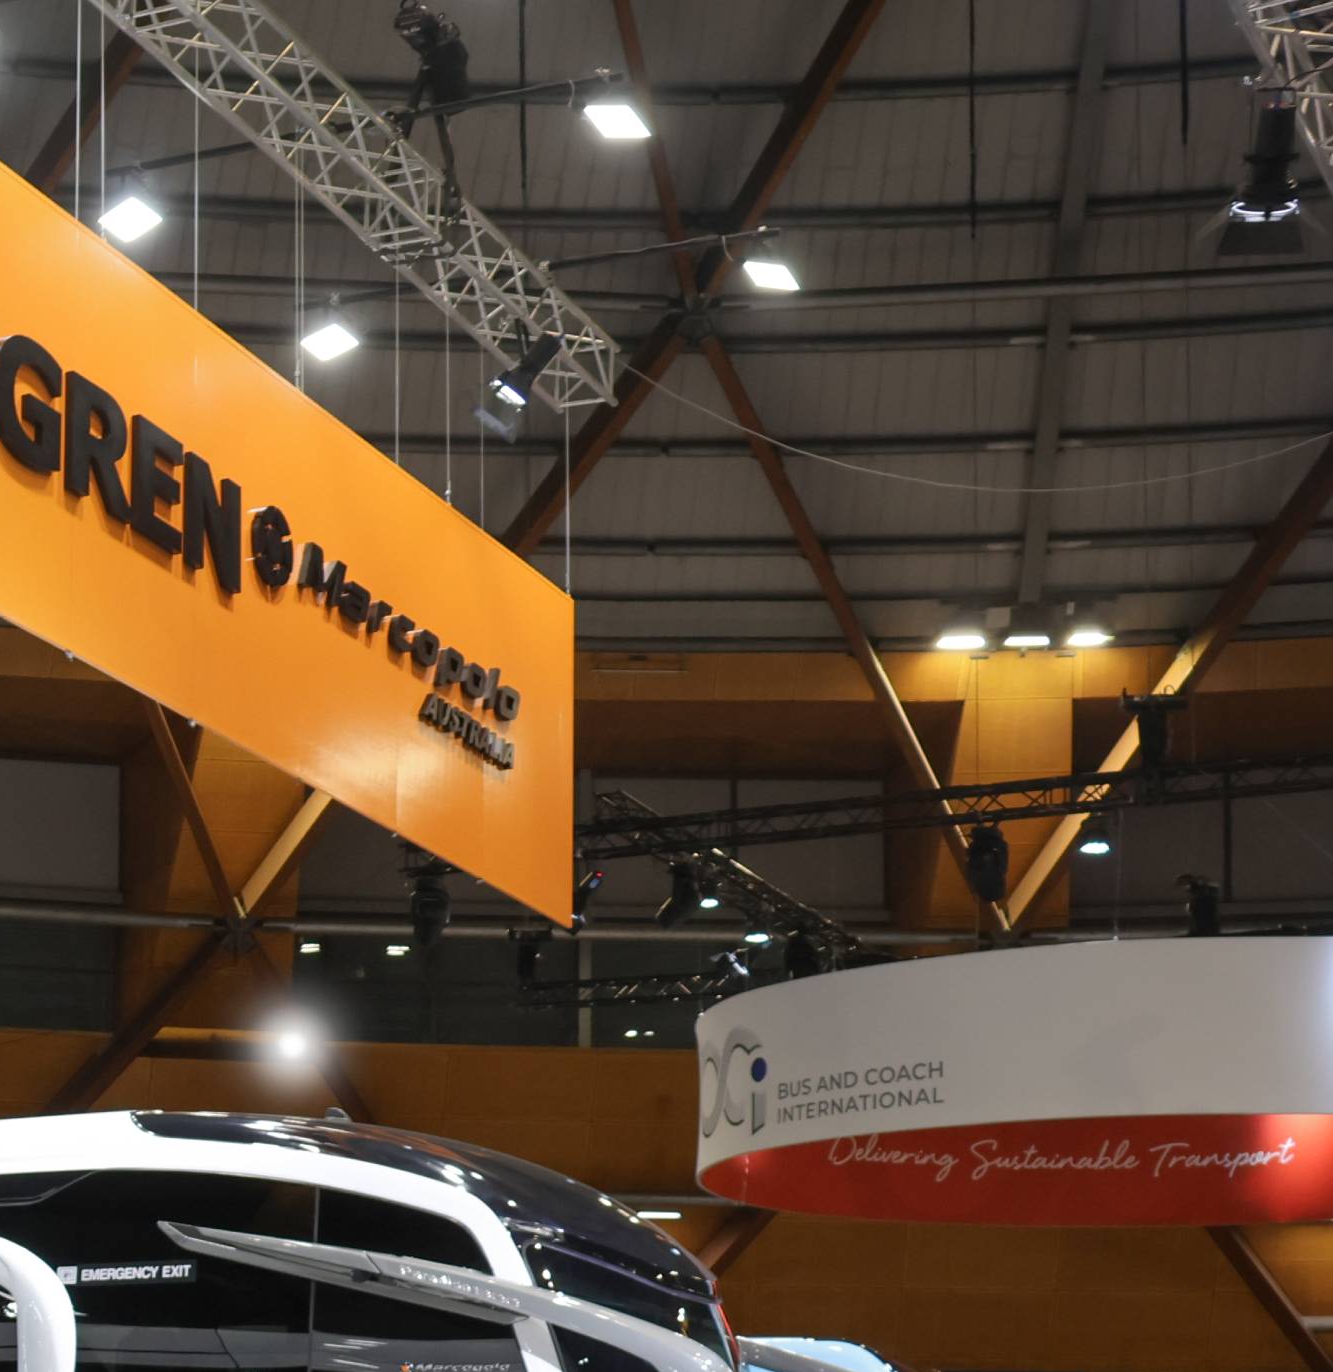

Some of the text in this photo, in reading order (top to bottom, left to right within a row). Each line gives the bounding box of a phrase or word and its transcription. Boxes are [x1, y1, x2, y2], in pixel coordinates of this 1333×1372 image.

[297, 540, 521, 722] Marcopolo
[419, 692, 515, 770] AUSTRALIA
[778, 1061, 944, 1100] BUS AND COACH
[777, 1087, 945, 1125] INTERNATIONAL
[827, 1133, 1295, 1181] Delivering Sustainable Transport
[80, 1264, 192, 1282] EMERGENCY EXIT
